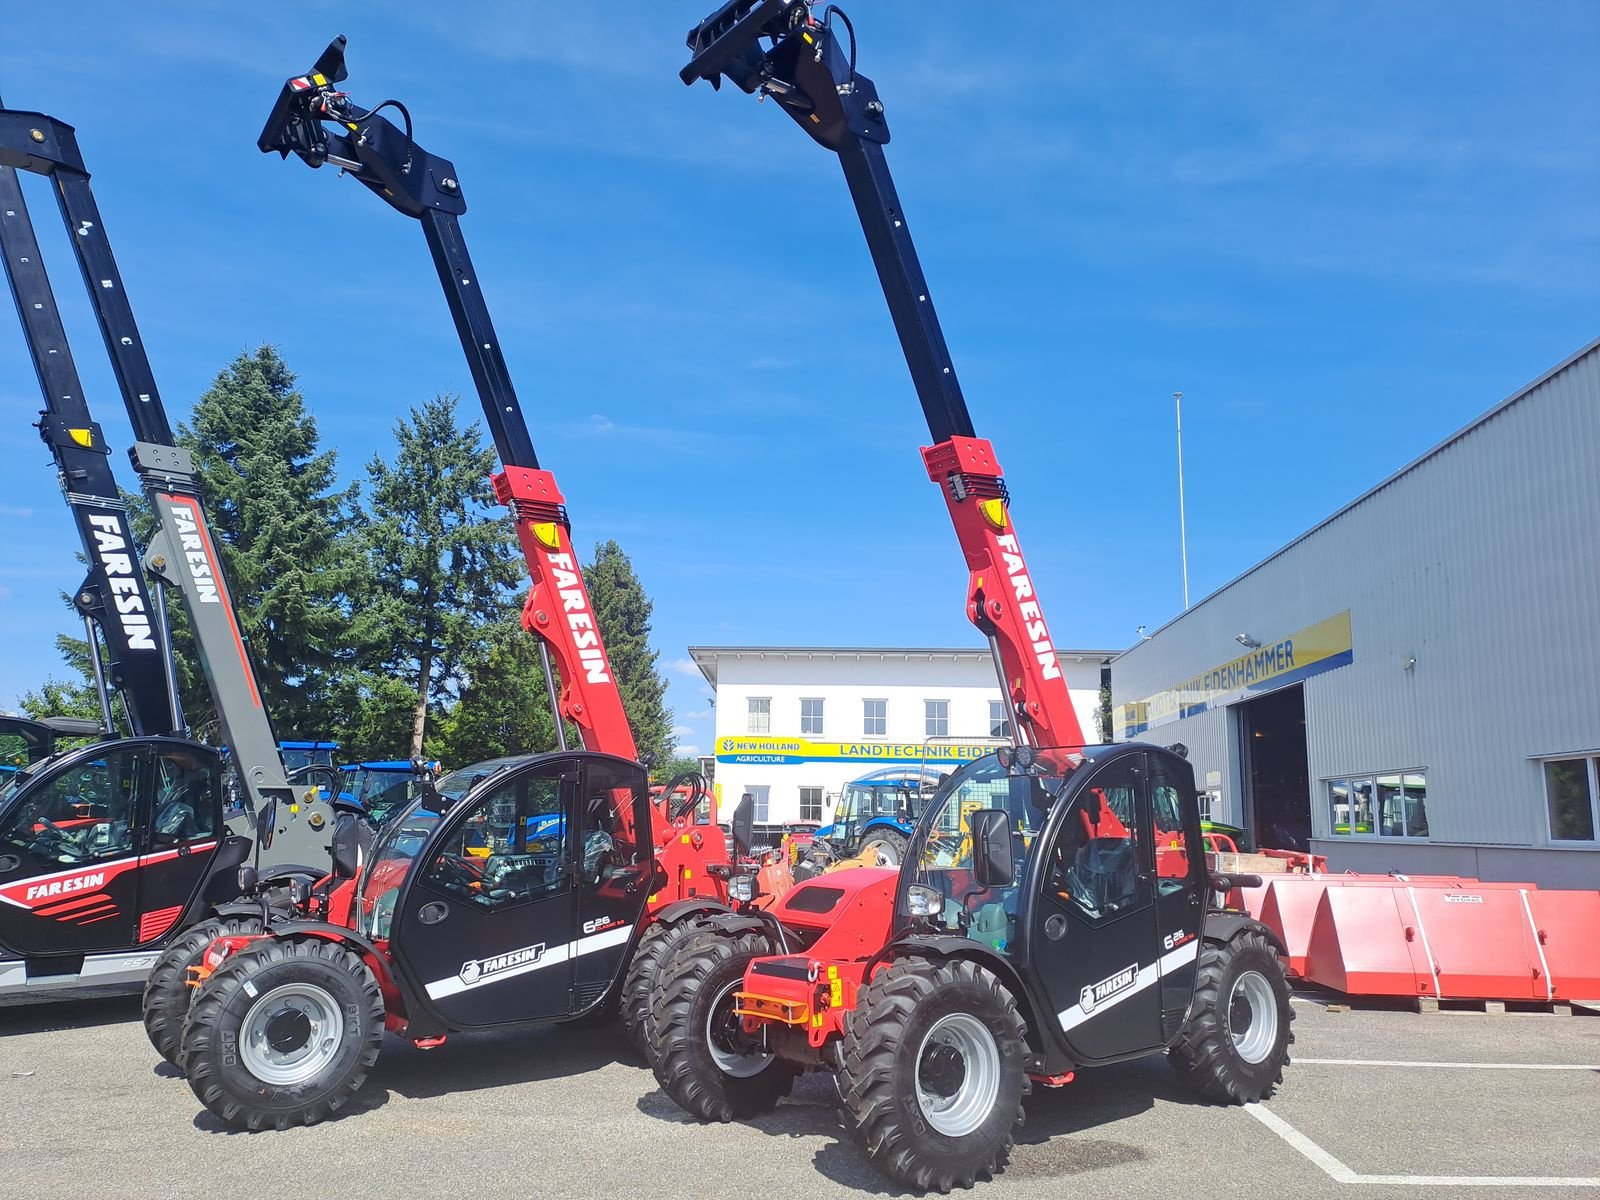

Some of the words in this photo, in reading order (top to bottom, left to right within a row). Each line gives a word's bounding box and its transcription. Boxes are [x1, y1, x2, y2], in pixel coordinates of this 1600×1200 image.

[170, 506, 220, 603] FARESIN
[88, 514, 157, 650] FARESIN
[547, 552, 611, 684] FARESIN
[995, 534, 1061, 681] FARESIN
[735, 755, 785, 763] AGRICULTURE
[736, 742, 757, 750] NEW
[759, 743, 800, 751] HOLLAND
[839, 744, 954, 758] LANDTECHNIK
[26, 872, 105, 900] FARESIN
[483, 948, 536, 974] FARESIN
[1095, 970, 1133, 1001] FARESIN
[346, 1004, 361, 1037] BKT
[222, 1031, 236, 1066] BKT
